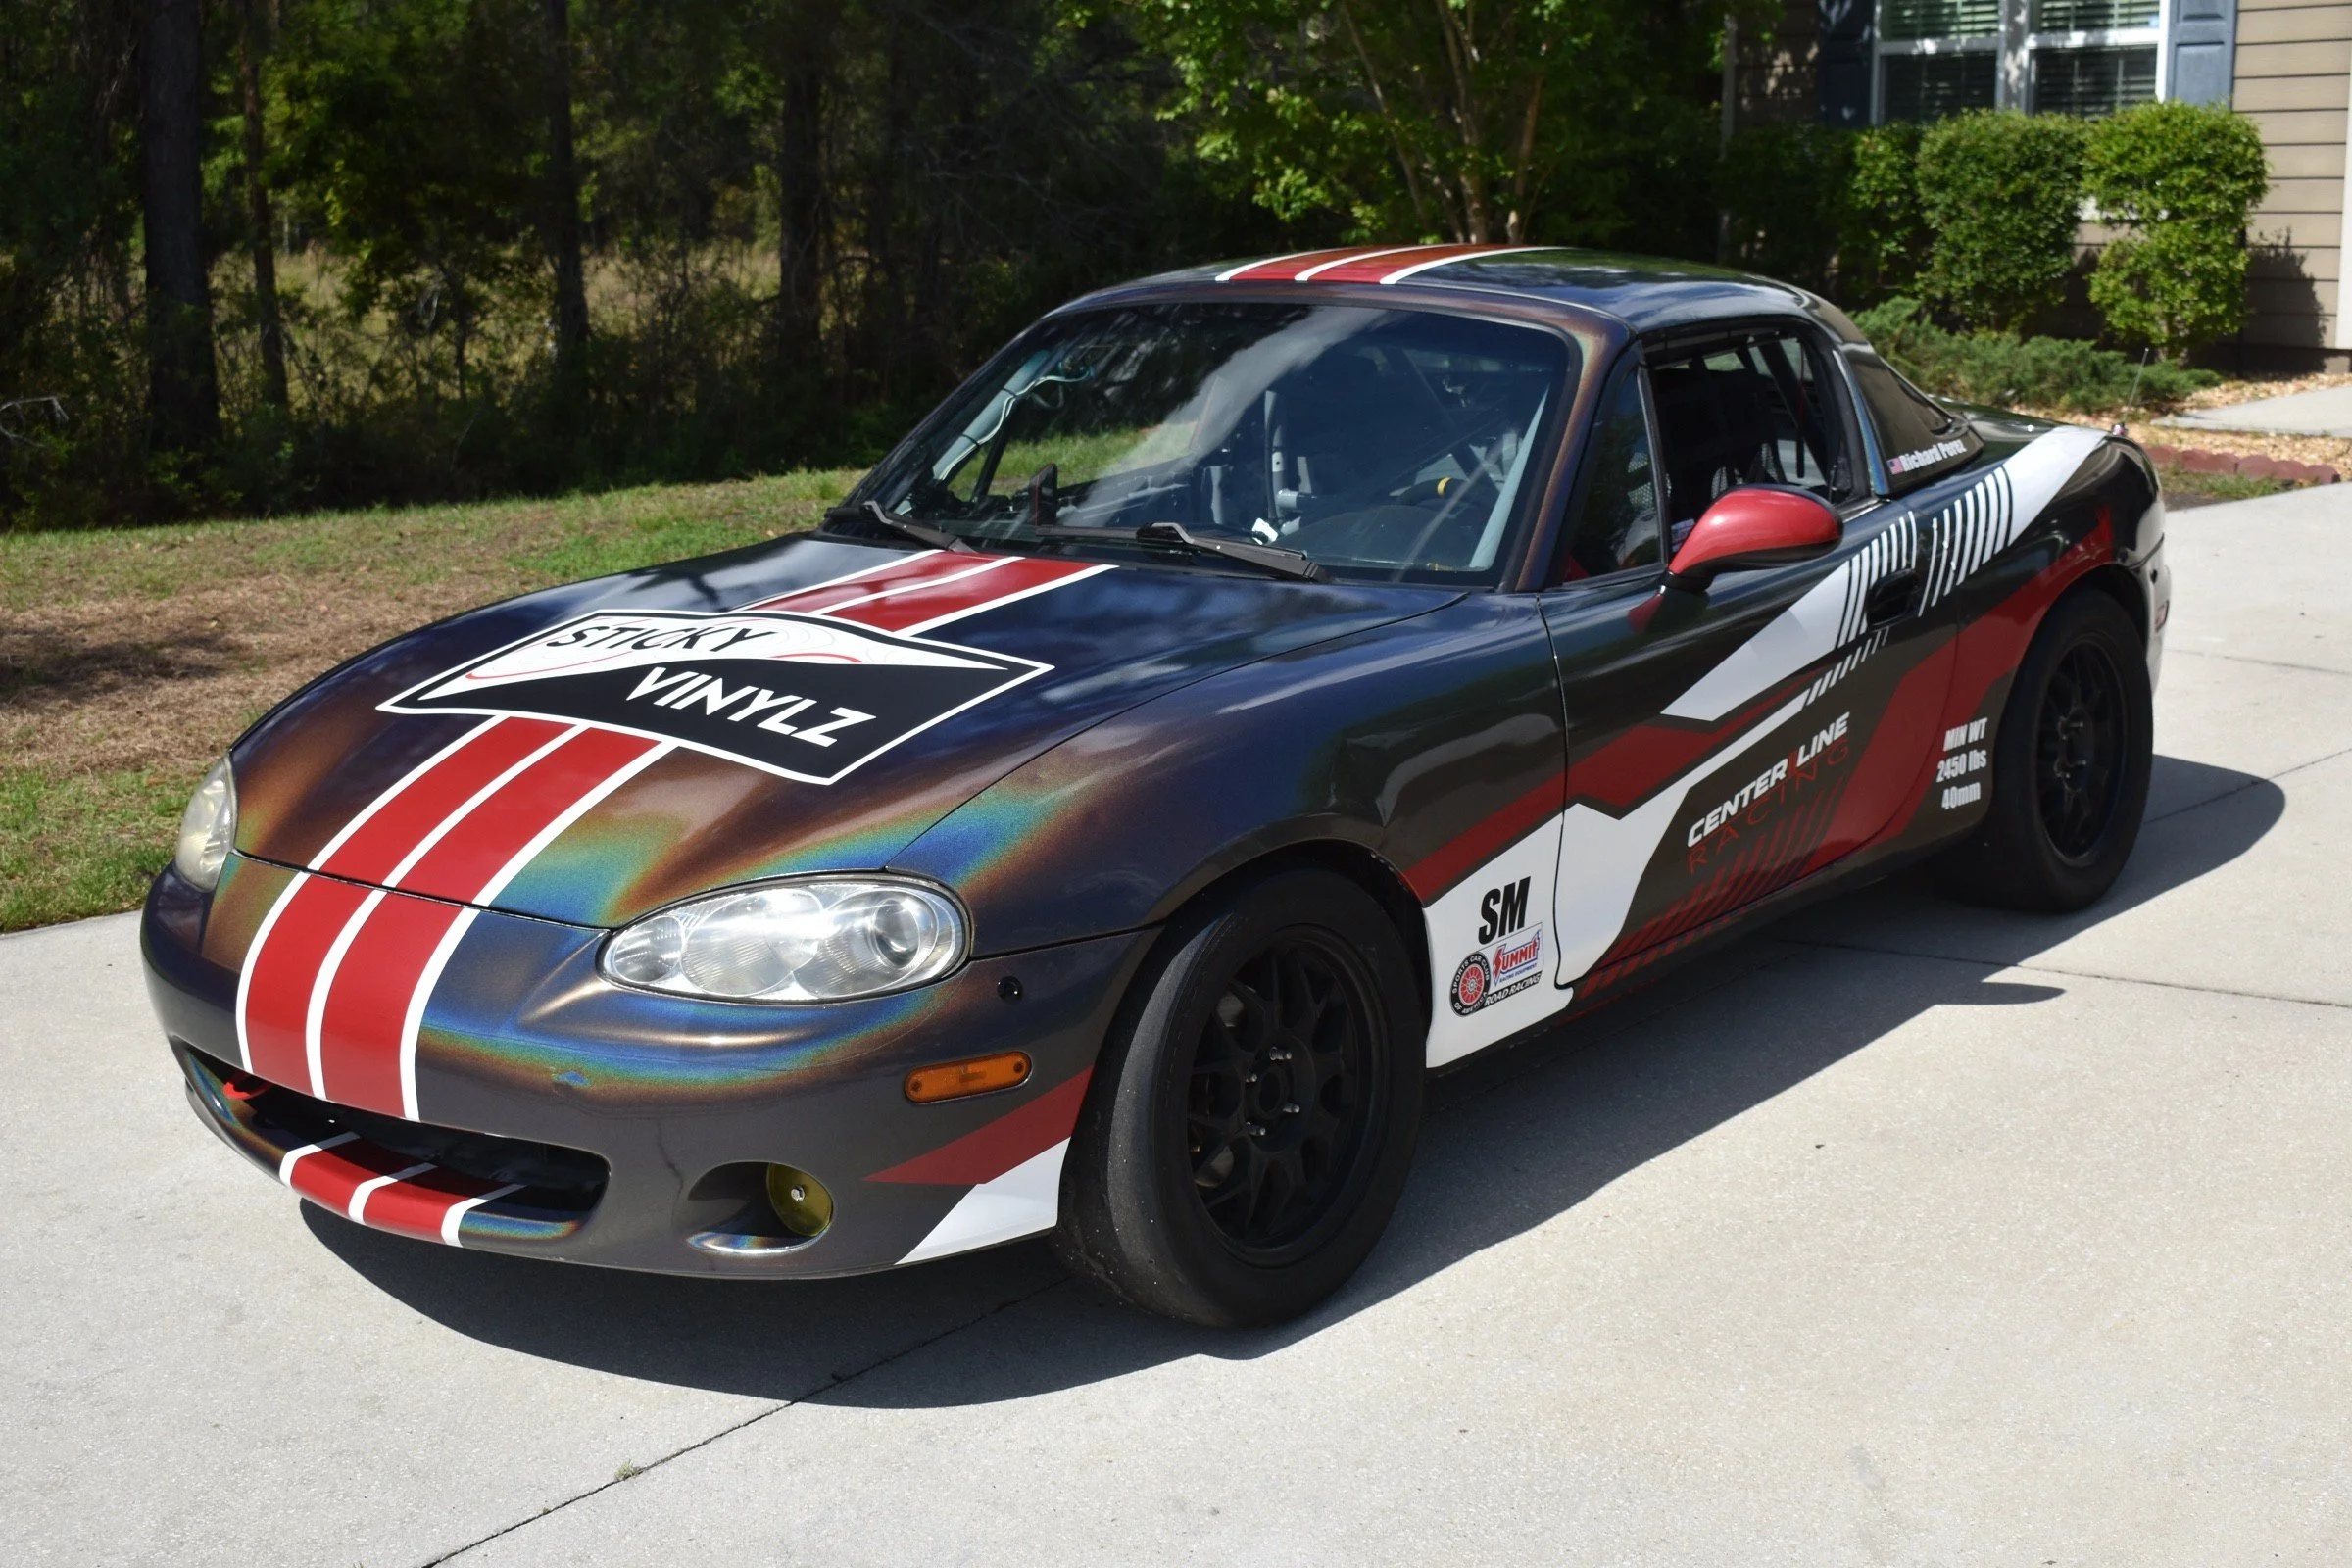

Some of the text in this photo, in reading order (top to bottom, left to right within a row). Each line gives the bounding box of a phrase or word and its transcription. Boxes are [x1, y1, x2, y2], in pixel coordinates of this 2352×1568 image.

[1899, 444, 1942, 472] Richard
[546, 625, 777, 653] STICKY
[625, 666, 877, 748] VINYLZ
[1942, 717, 1988, 752] MIN WT
[1688, 711, 1851, 848] CENTER LINE
[1936, 749, 1987, 783] 2450 lbs
[1941, 782, 1981, 810] 40mm
[1478, 875, 1532, 945] SM
[1451, 955, 1491, 994] SPORTS CAR CLUB
[1484, 972, 1542, 1006] ROAD RACING
